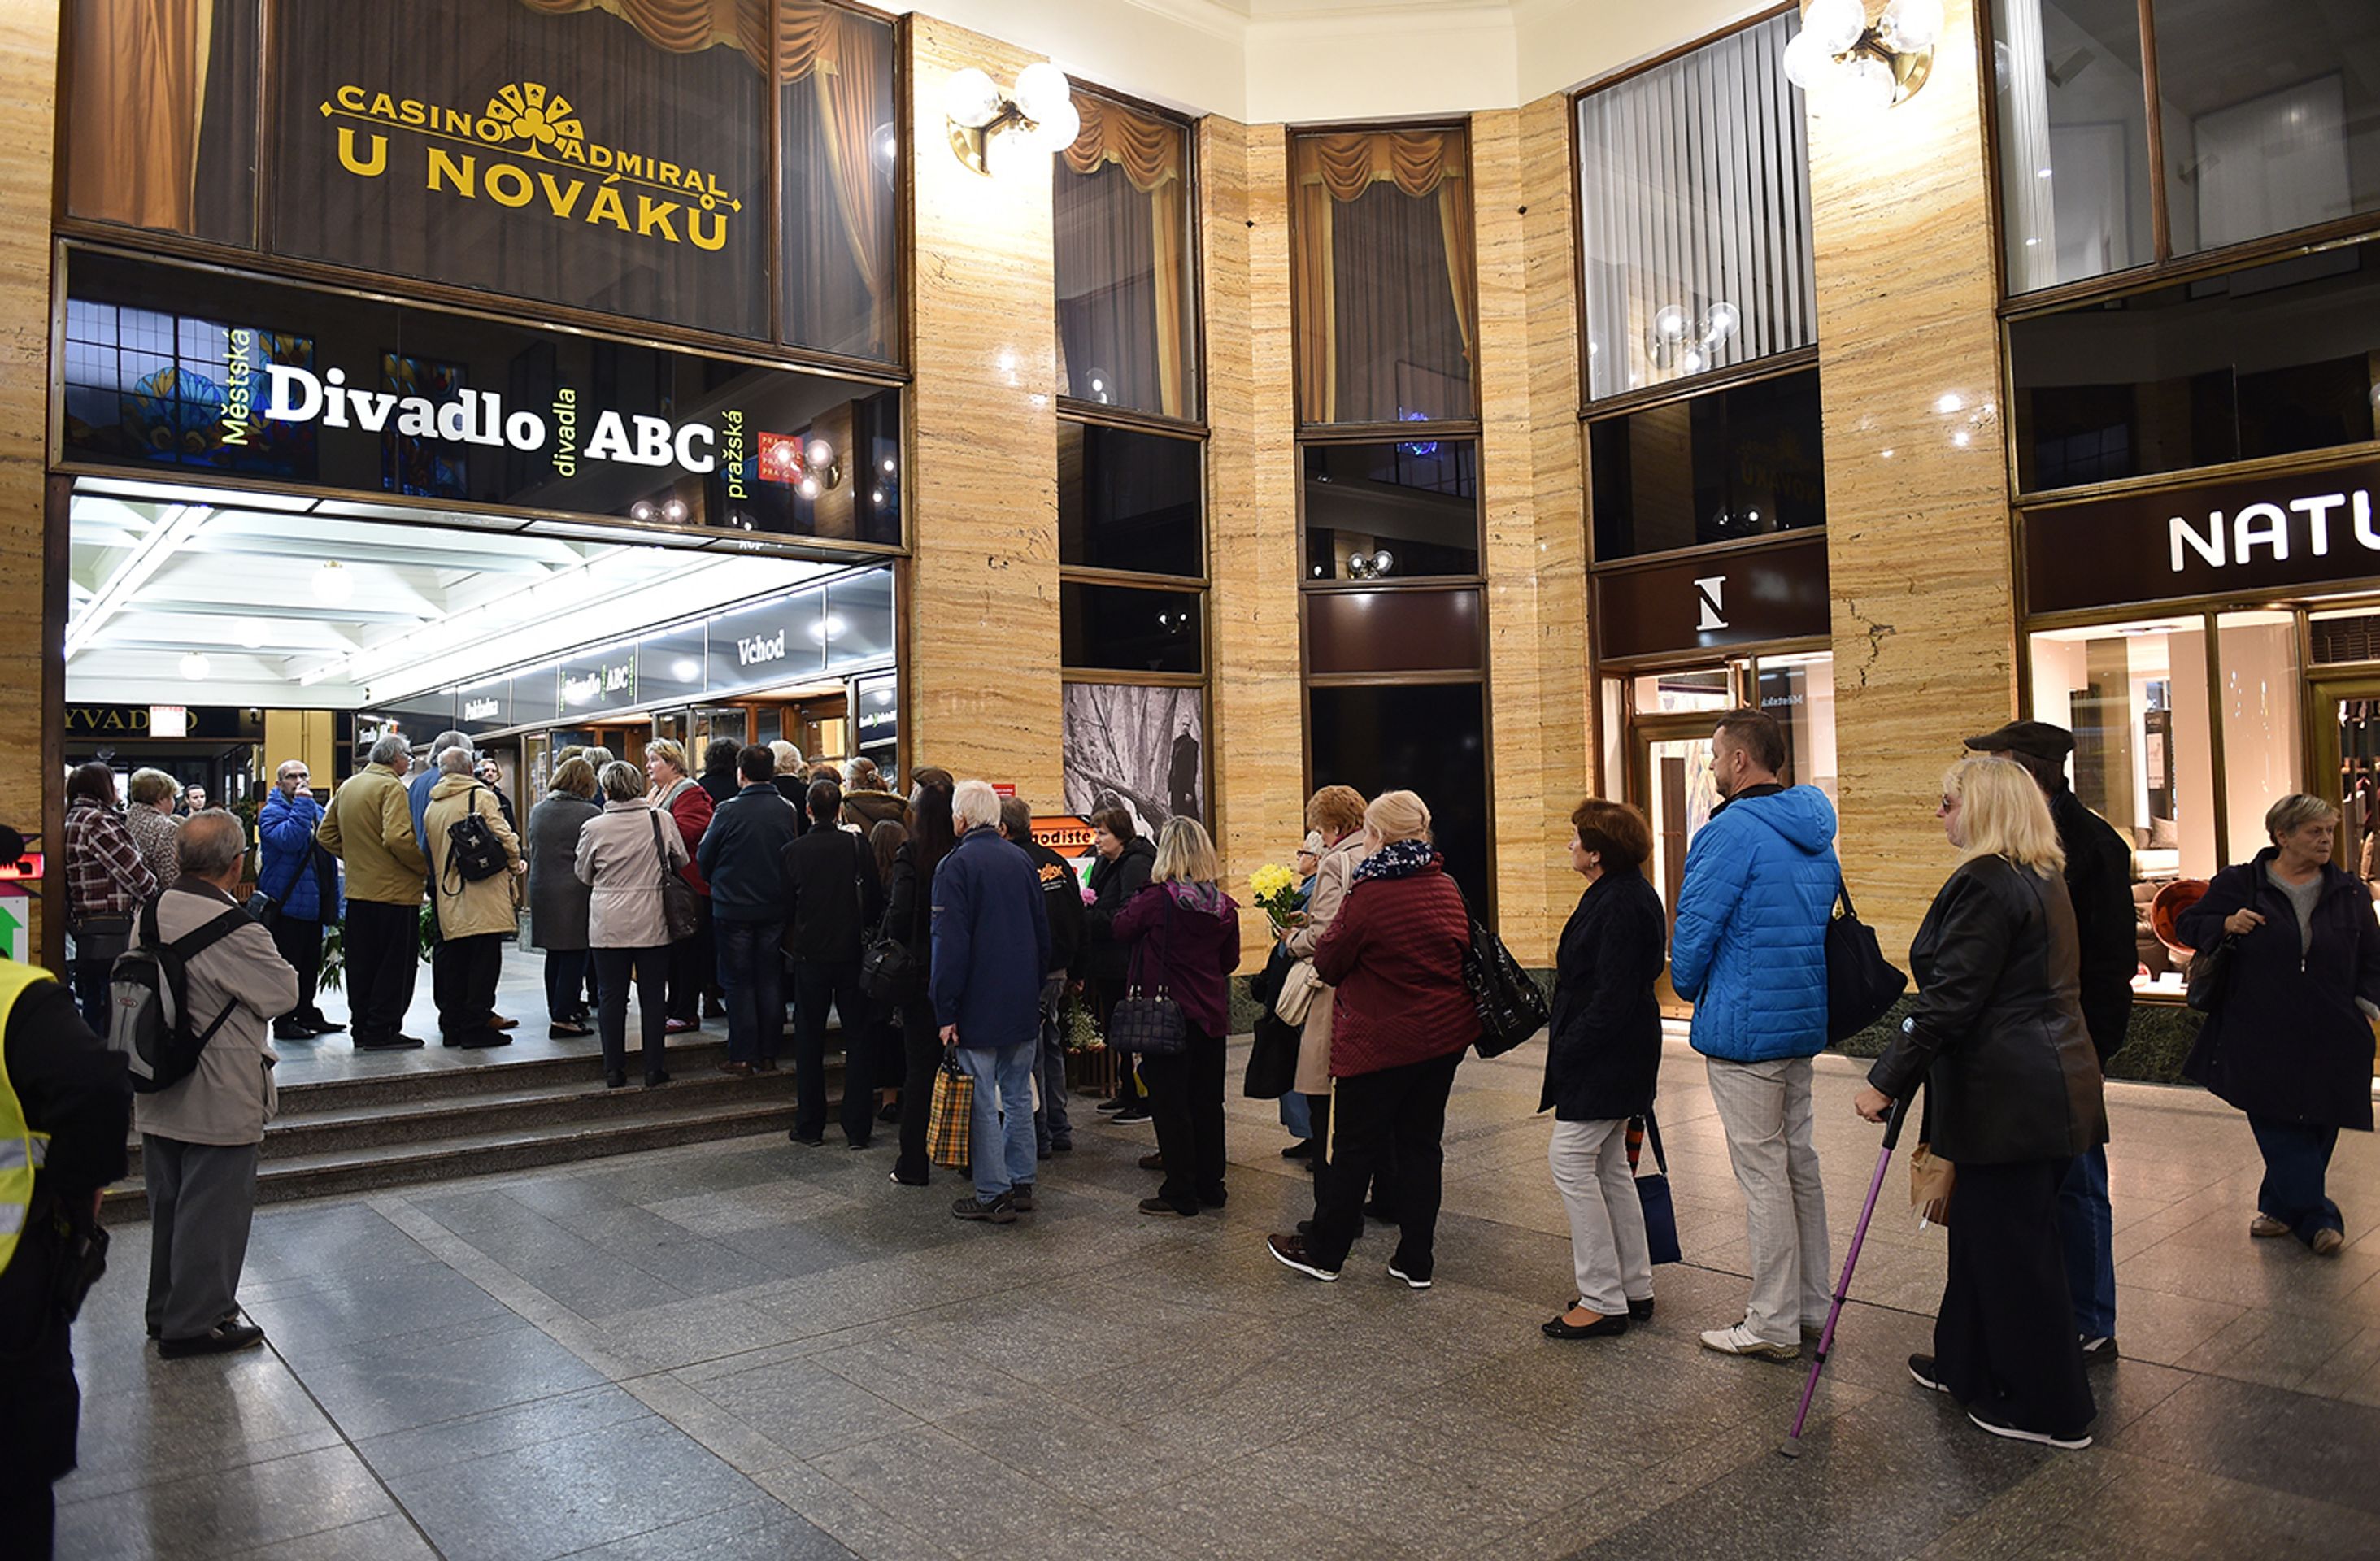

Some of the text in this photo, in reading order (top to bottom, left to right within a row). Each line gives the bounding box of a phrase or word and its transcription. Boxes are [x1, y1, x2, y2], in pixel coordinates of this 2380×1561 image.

[337, 85, 728, 198] CASINO ADMIRAL
[337, 127, 727, 251] U NOVÁKŮ
[221, 328, 250, 446] Městská
[263, 364, 715, 473] Divadlo ABC
[552, 388, 576, 477] divadla
[722, 410, 748, 498] pražská
[2169, 489, 2380, 572] NATU
[737, 628, 785, 666] Vchod
[1693, 576, 1730, 631] N
[606, 665, 629, 692] ABC
